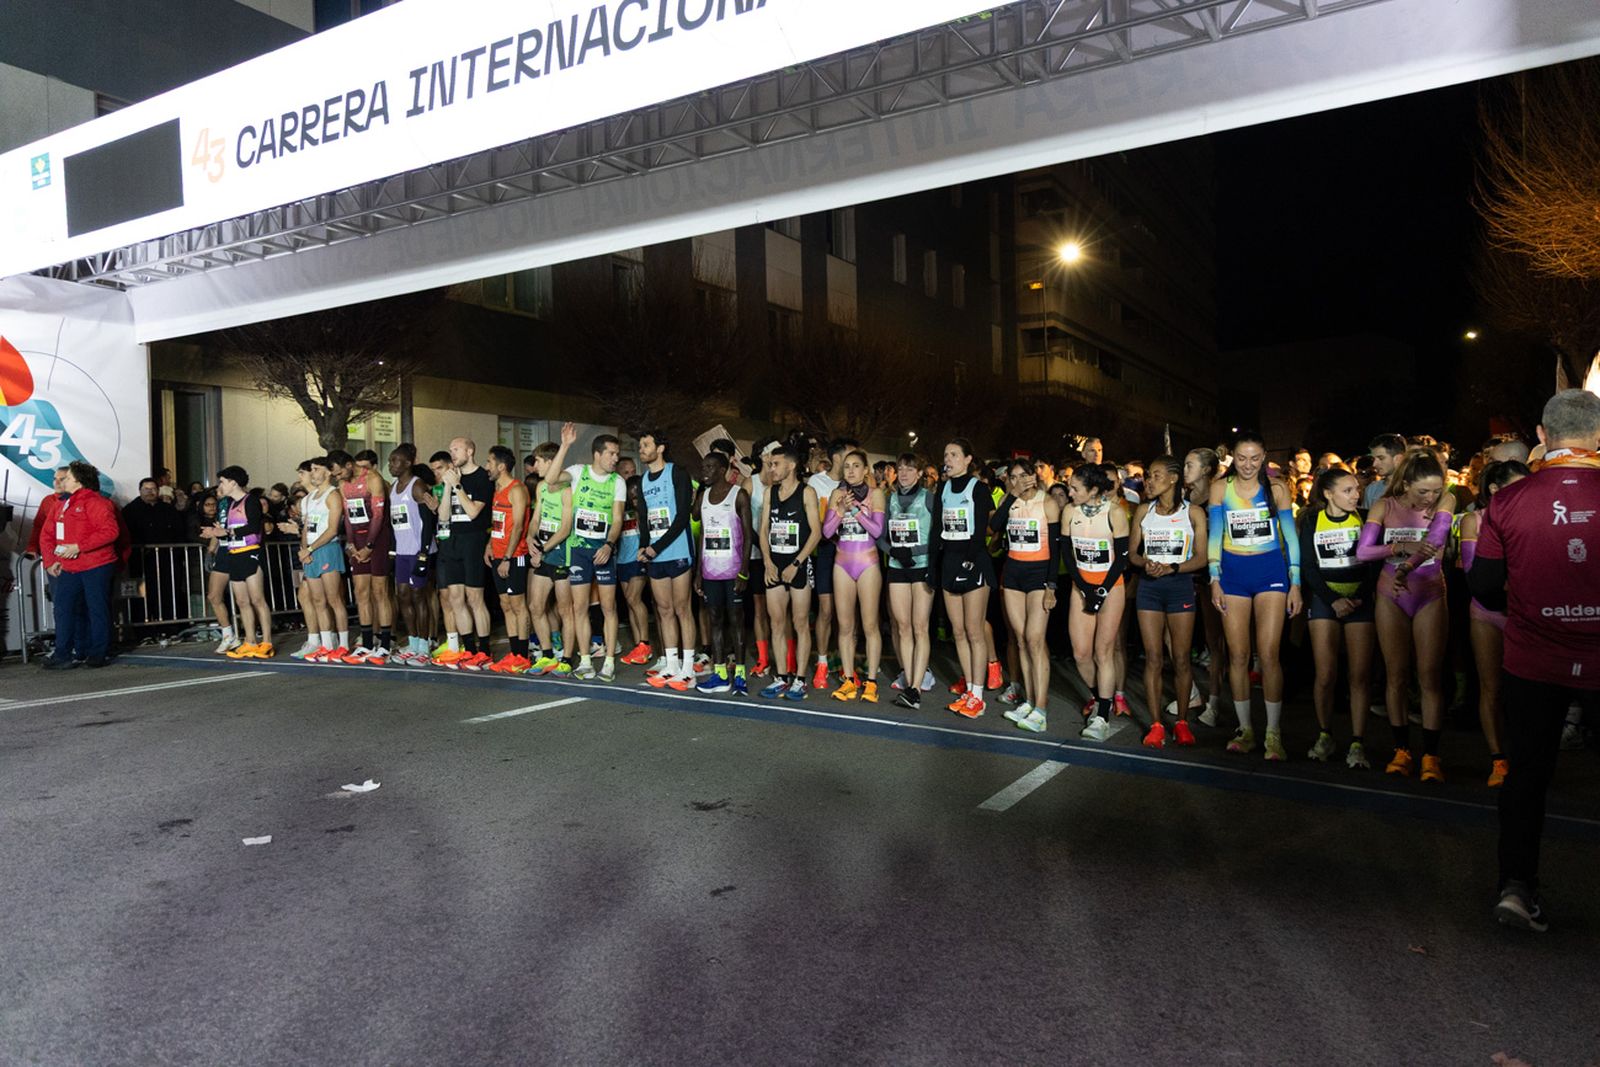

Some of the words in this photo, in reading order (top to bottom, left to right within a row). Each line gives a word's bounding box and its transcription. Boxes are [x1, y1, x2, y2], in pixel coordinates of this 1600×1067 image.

[192, 127, 226, 183] 43
[236, 80, 390, 169] CARRERA
[406, 0, 767, 118] INTERNACIO
[0, 413, 63, 469] 43
